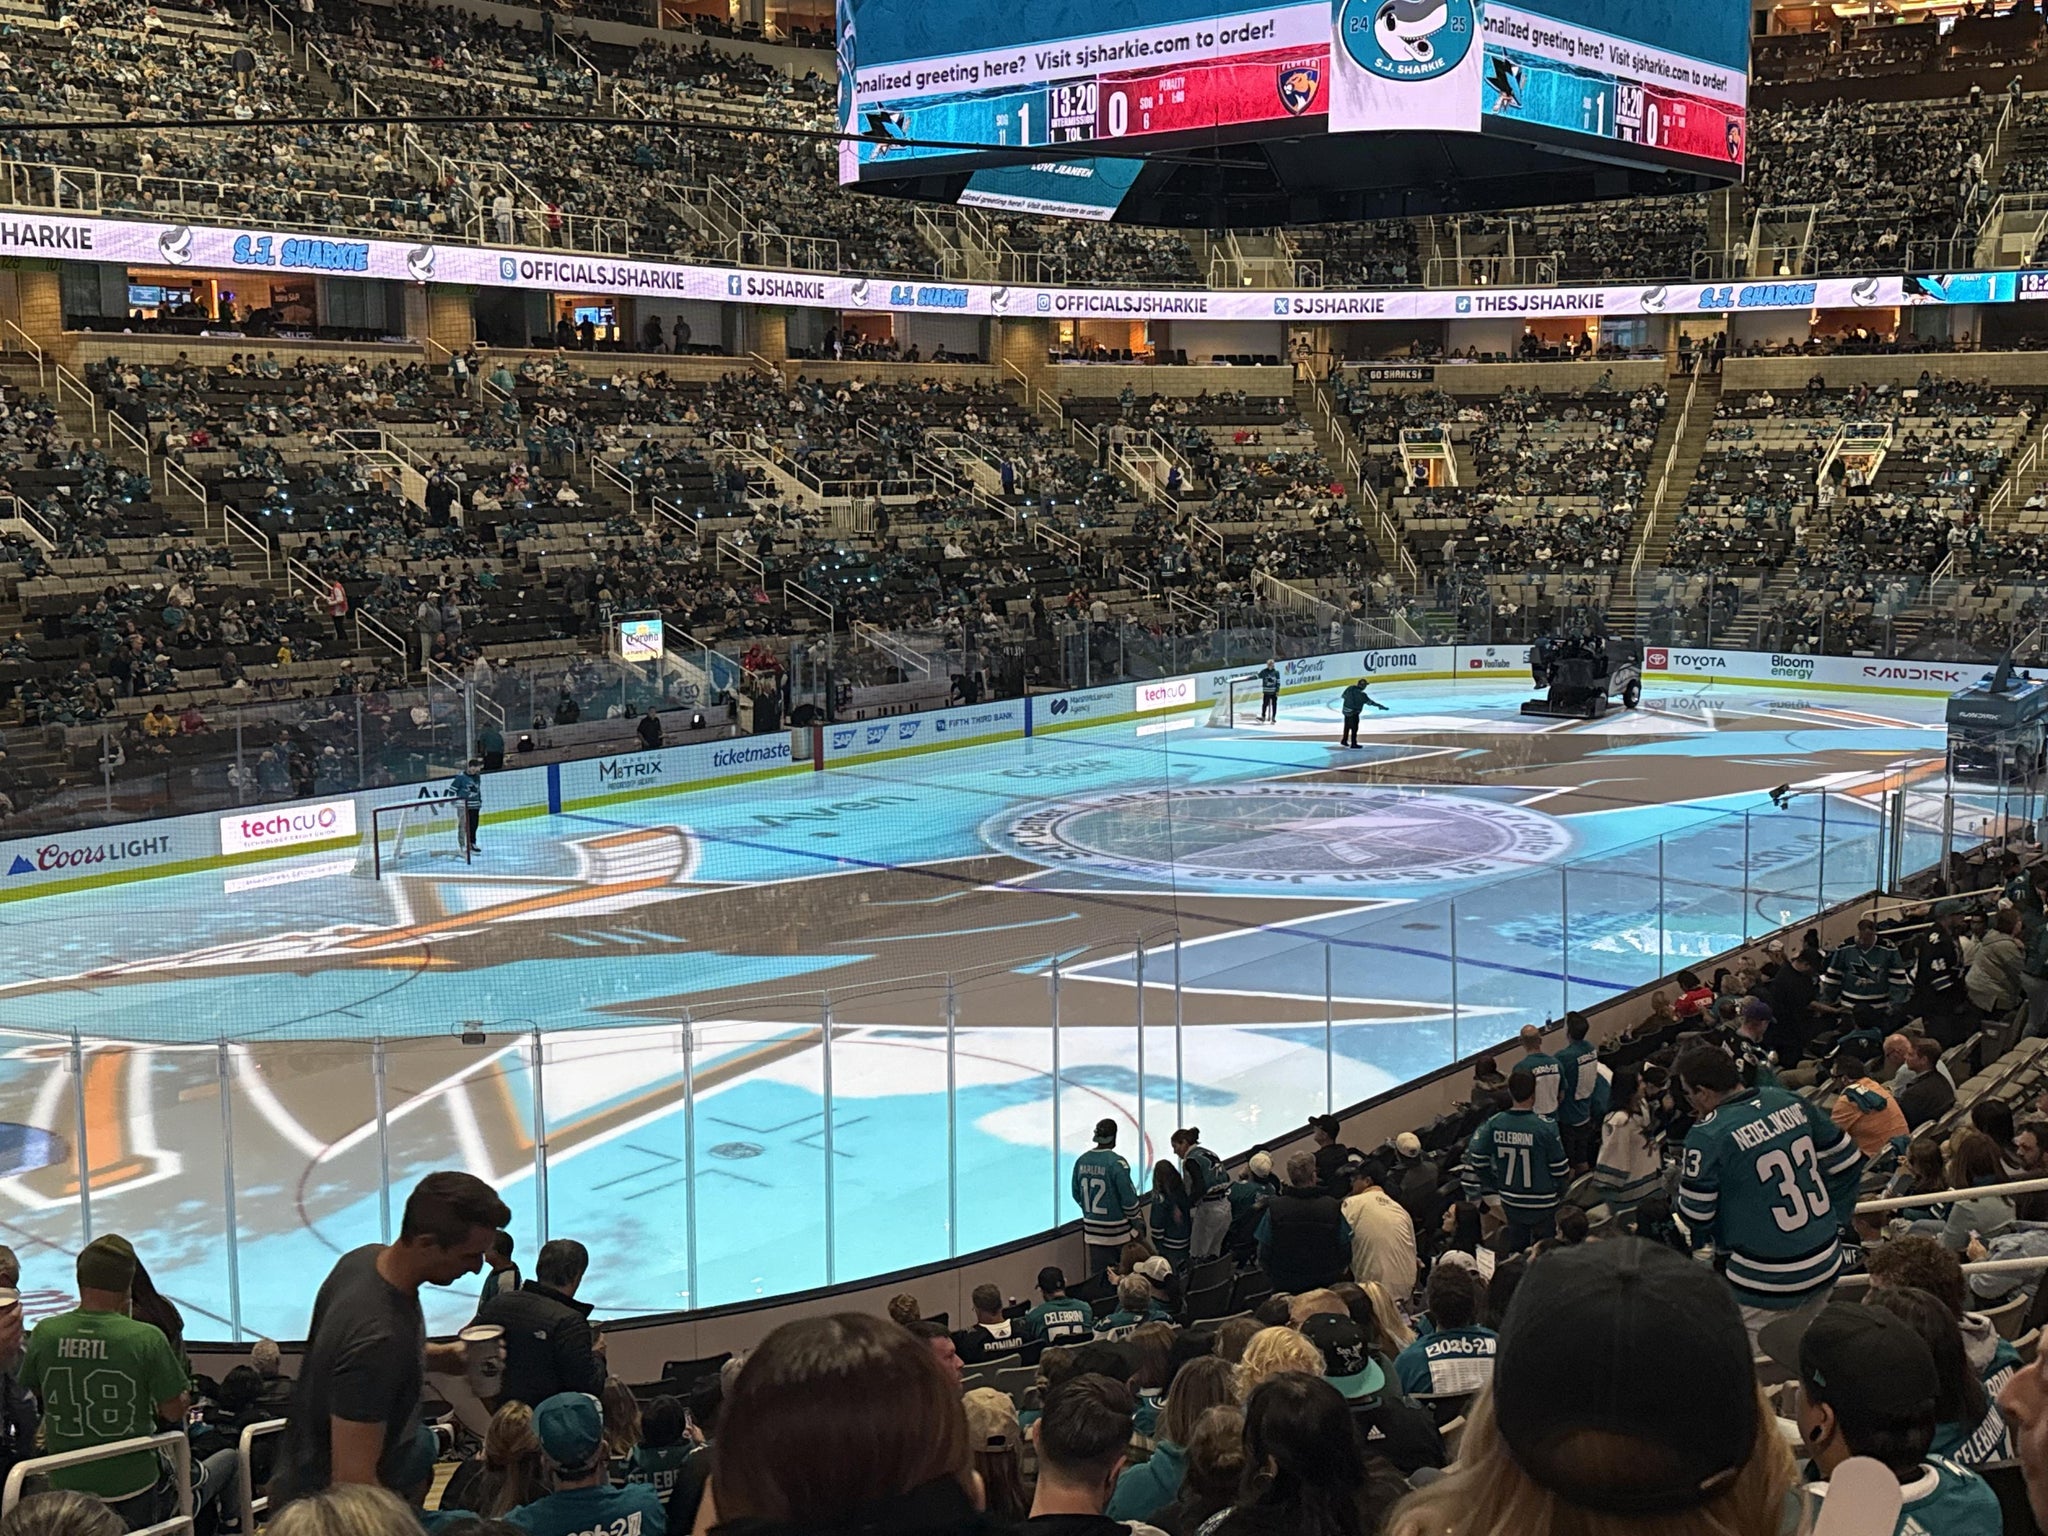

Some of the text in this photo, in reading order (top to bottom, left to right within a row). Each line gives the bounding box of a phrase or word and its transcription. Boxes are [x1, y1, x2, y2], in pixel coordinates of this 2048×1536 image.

[1350, 17, 1368, 33] 24
[1451, 16, 1466, 32] 25
[916, 62, 979, 90] greeting
[983, 56, 1026, 78] here?
[1035, 49, 1071, 71] Visit
[1075, 34, 1190, 69] sjsharkie.com
[1196, 30, 1213, 49] to
[1219, 19, 1275, 44] order!
[1375, 57, 1445, 74] S.J. SHARKIE
[1532, 27, 1575, 57] greeting
[1578, 39, 1604, 60] here?
[1609, 44, 1630, 67] Visit
[1632, 52, 1689, 83] sjsharkie.com
[1692, 70, 1700, 85] to
[1703, 75, 1727, 93] order!
[1052, 84, 1096, 118] 13:20
[1018, 103, 1029, 145] 1
[1108, 91, 1128, 137] 0
[1596, 91, 1605, 135] 1
[1647, 103, 1659, 146] 0
[2, 223, 93, 249] HARKIE
[234, 235, 369, 271] S.J. SHARKIE
[521, 259, 684, 290] OFFICIALSJSHARKIE
[747, 277, 825, 299] SJSHARKIE
[1700, 283, 1817, 309] S.J. SHARKIE
[1988, 275, 1996, 300] 1
[1055, 294, 1208, 313] OFFICIALSJSHARKIE
[1293, 298, 1384, 314] SJSHARKIE
[1475, 293, 1604, 312] THESJSHARKIE
[1370, 370, 1382, 379] GO
[1296, 659, 1325, 676] Sports
[1364, 651, 1417, 673] Corona
[1484, 659, 1510, 668] YouTube
[1673, 655, 1726, 667] TOYOTA
[1771, 655, 1814, 669] Bloom
[1286, 674, 1321, 685] CALIFORNIA
[1771, 667, 1813, 681] energy
[1863, 665, 1959, 682] SANDISK
[900, 723, 918, 738] SAP
[949, 712, 1014, 730] FIFTH THIRD BANK
[834, 733, 852, 748] SAP
[867, 728, 885, 744] SAP
[713, 742, 791, 767] ticketmaste
[1007, 808, 1070, 838] Center
[37, 836, 170, 871] Coors LIGHT
[1731, 1102, 1808, 1151] NEDELJKOVIC
[1493, 1130, 1533, 1146] CELEBRINI
[1497, 1146, 1532, 1188] 71
[1756, 1135, 1830, 1232] 33
[1080, 1178, 1108, 1215] 12
[58, 1338, 109, 1360] HERTL
[42, 1366, 136, 1437] 48
